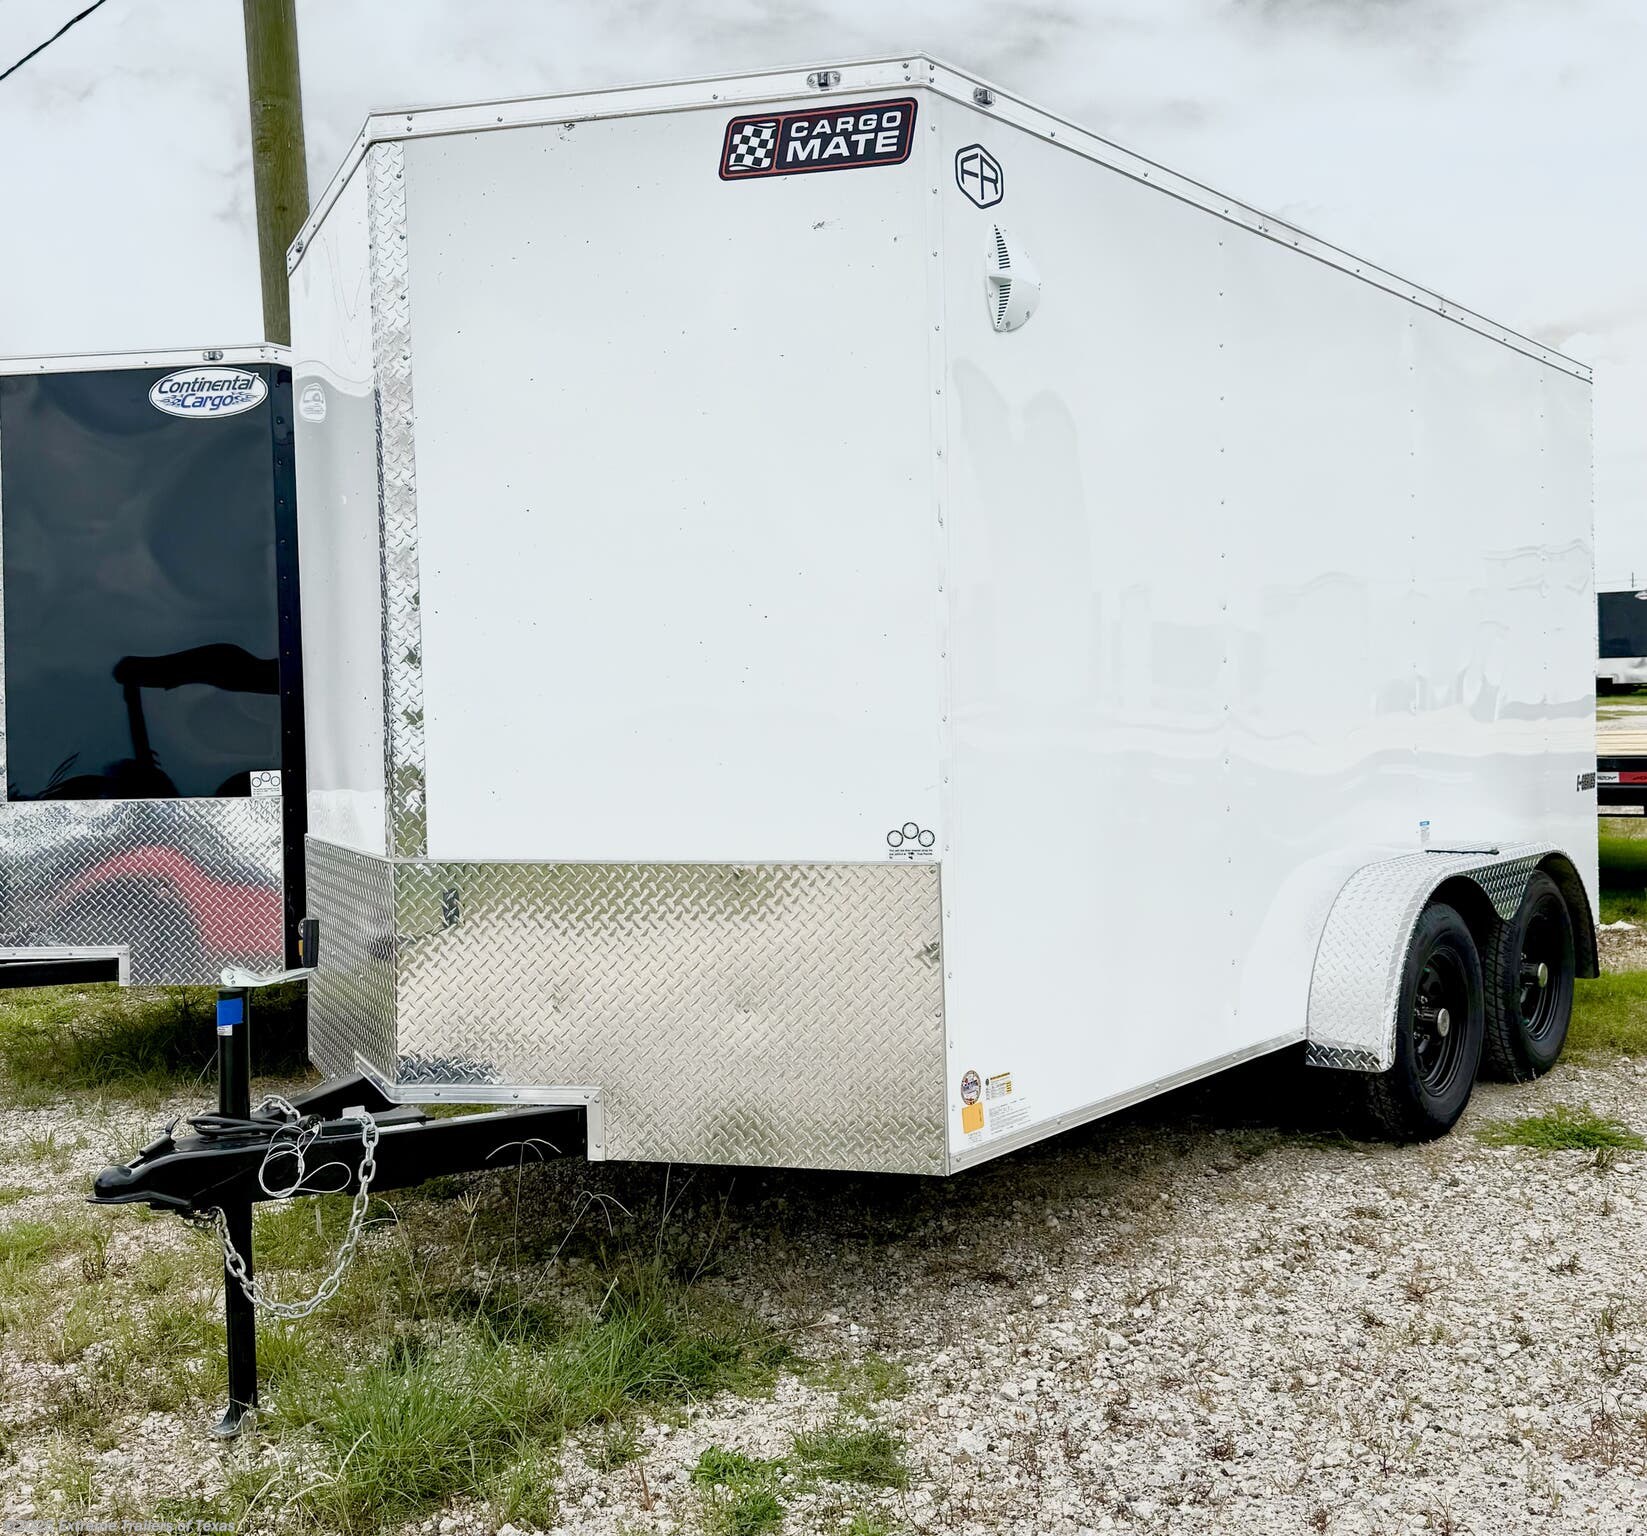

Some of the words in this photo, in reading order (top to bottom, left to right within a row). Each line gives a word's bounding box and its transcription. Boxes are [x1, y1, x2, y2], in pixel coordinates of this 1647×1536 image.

[790, 110, 902, 138] CARGO
[785, 130, 900, 163] MATE
[960, 152, 999, 200] FR
[158, 375, 257, 394] Continental
[180, 393, 234, 411] Cargo
